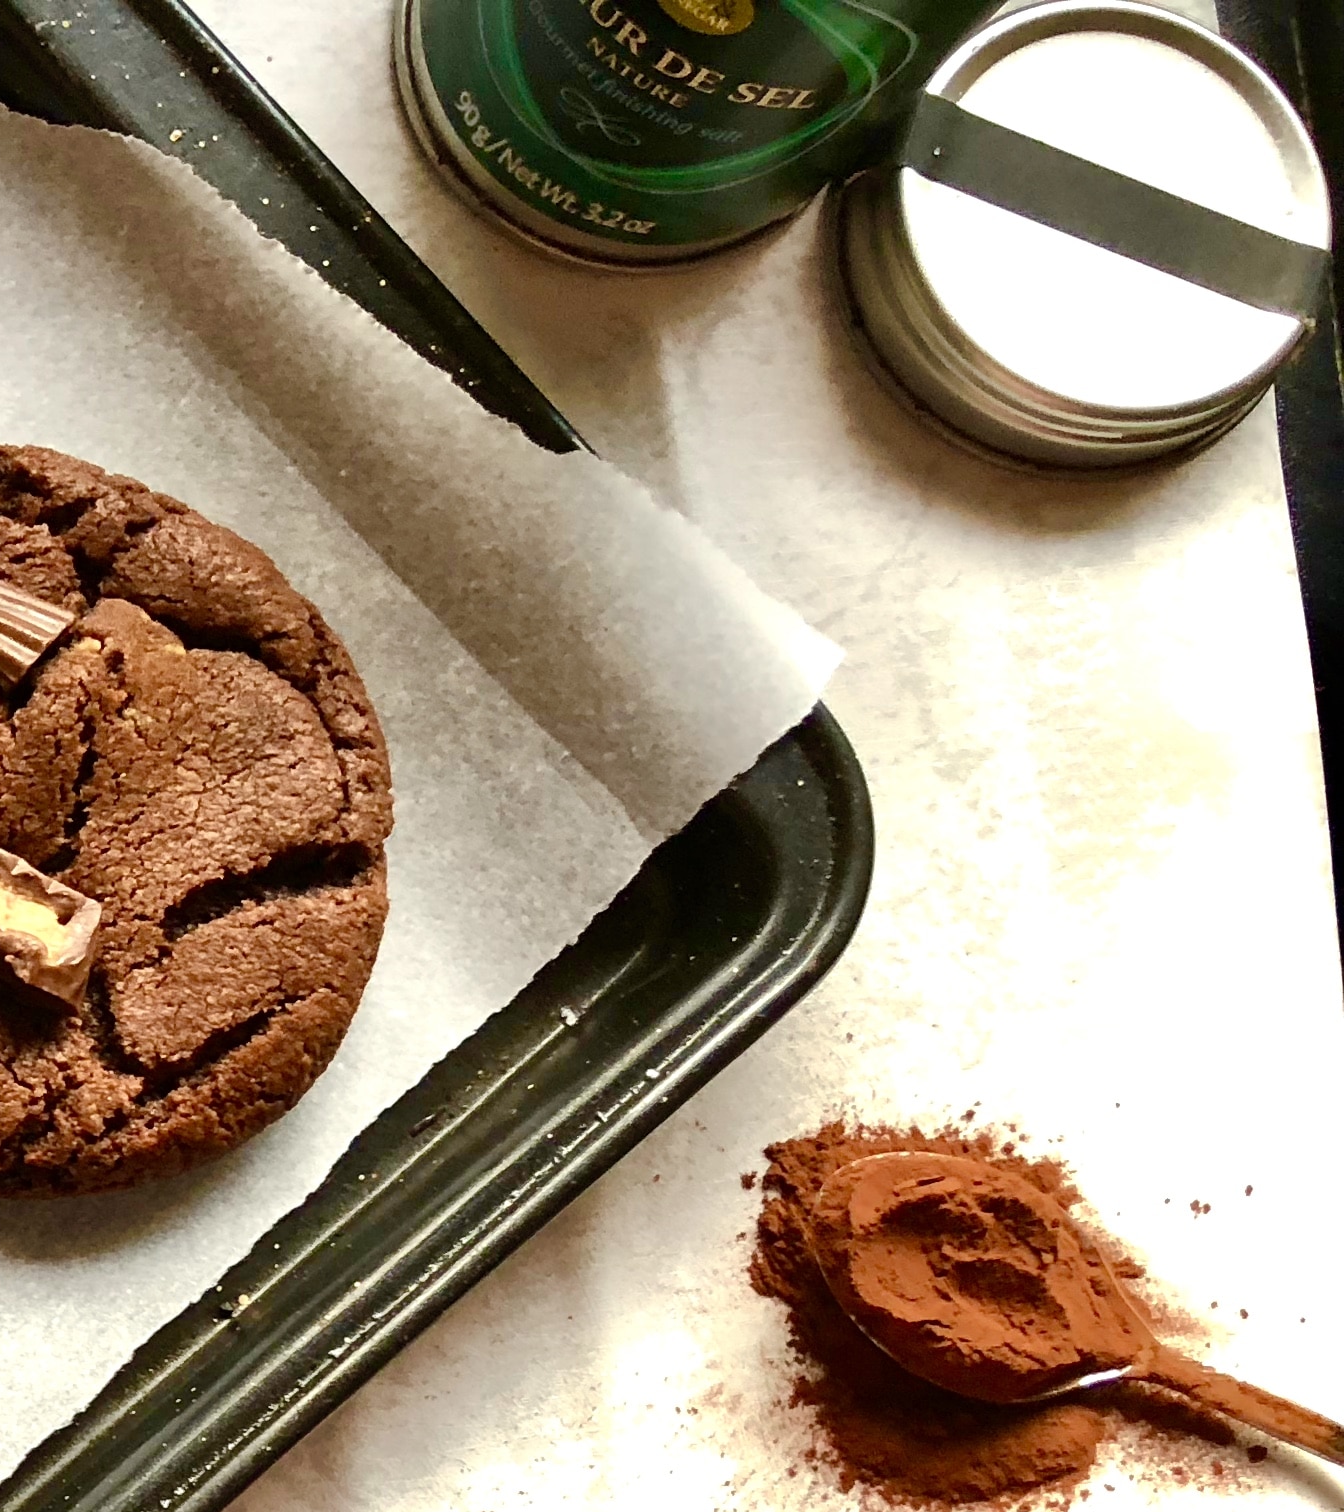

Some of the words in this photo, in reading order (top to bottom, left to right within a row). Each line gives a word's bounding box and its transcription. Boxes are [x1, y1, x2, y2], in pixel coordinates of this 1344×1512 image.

[579, 0, 648, 56] UR
[652, 48, 726, 94] DE
[727, 81, 816, 110] SEL
[586, 36, 691, 108] NATURE
[454, 90, 481, 127] 90
[622, 219, 657, 235] oz
